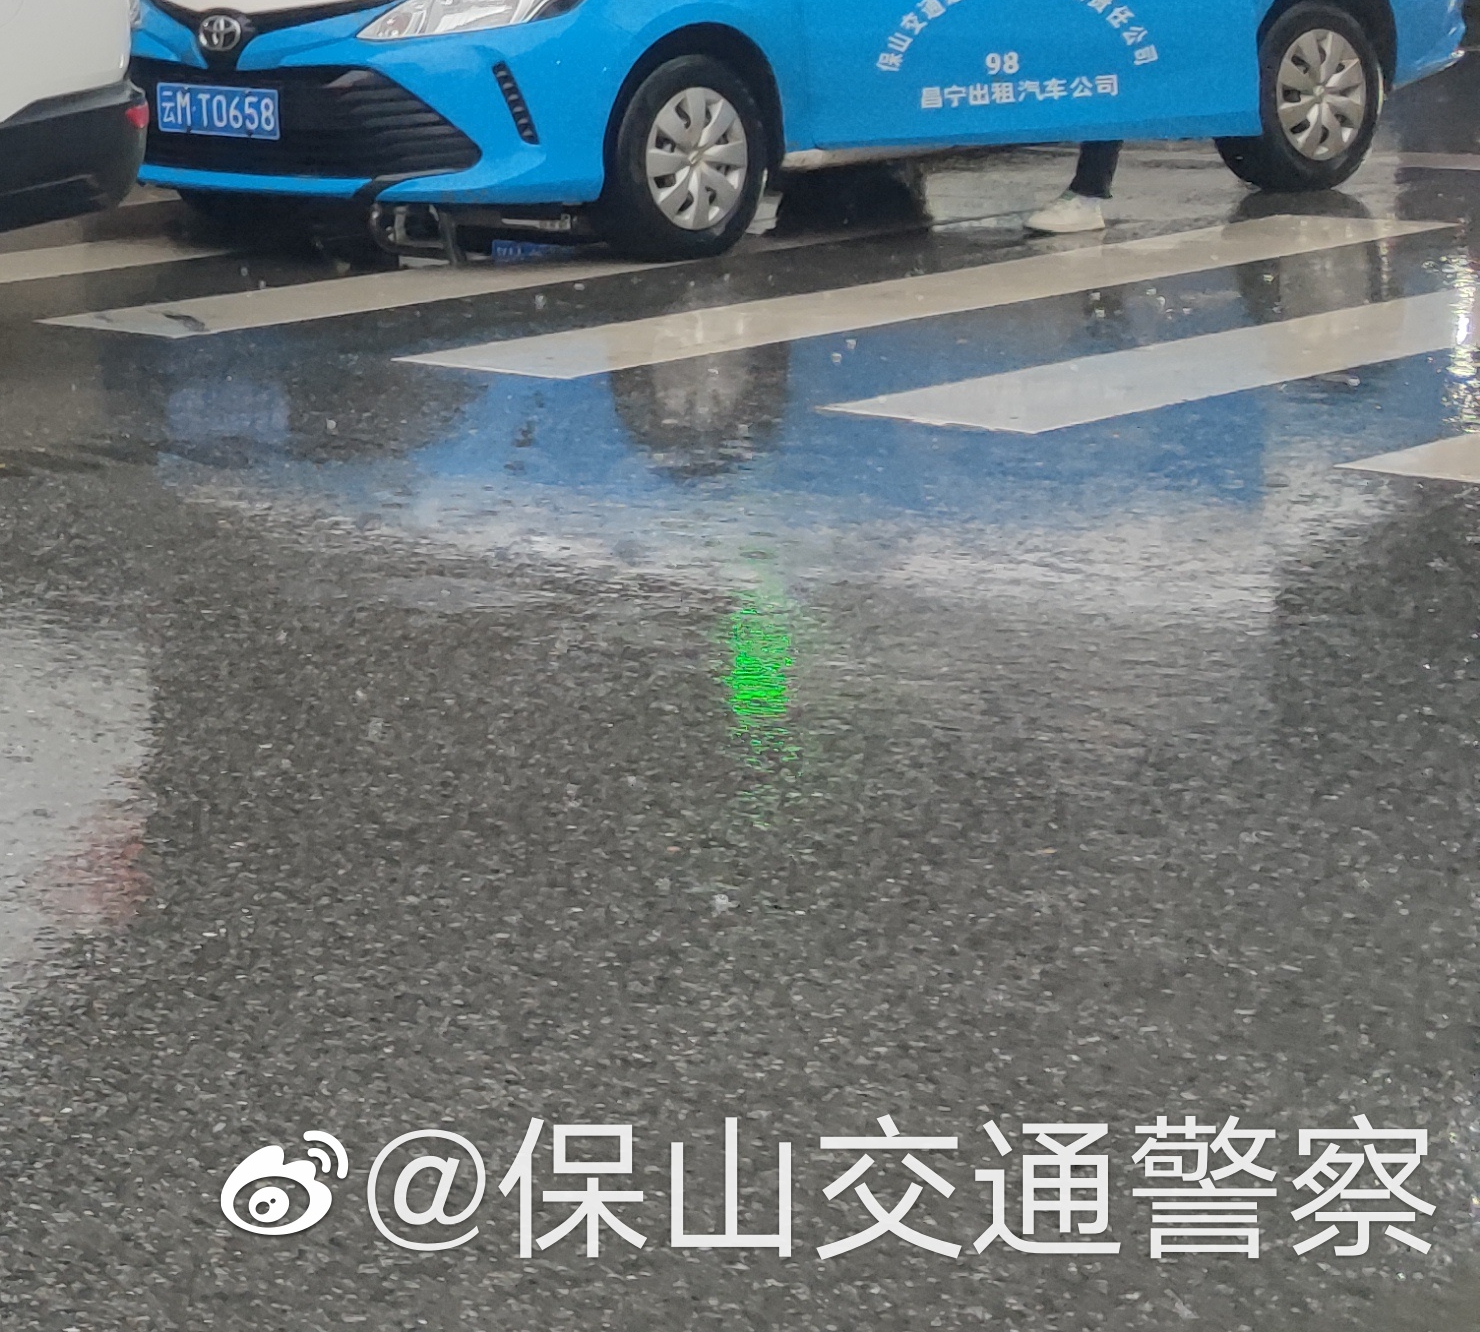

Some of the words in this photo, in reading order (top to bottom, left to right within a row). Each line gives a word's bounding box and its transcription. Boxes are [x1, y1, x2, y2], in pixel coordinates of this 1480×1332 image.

[985, 52, 1020, 75] 98
[921, 74, 1119, 109] 昌宁出租汽车公司
